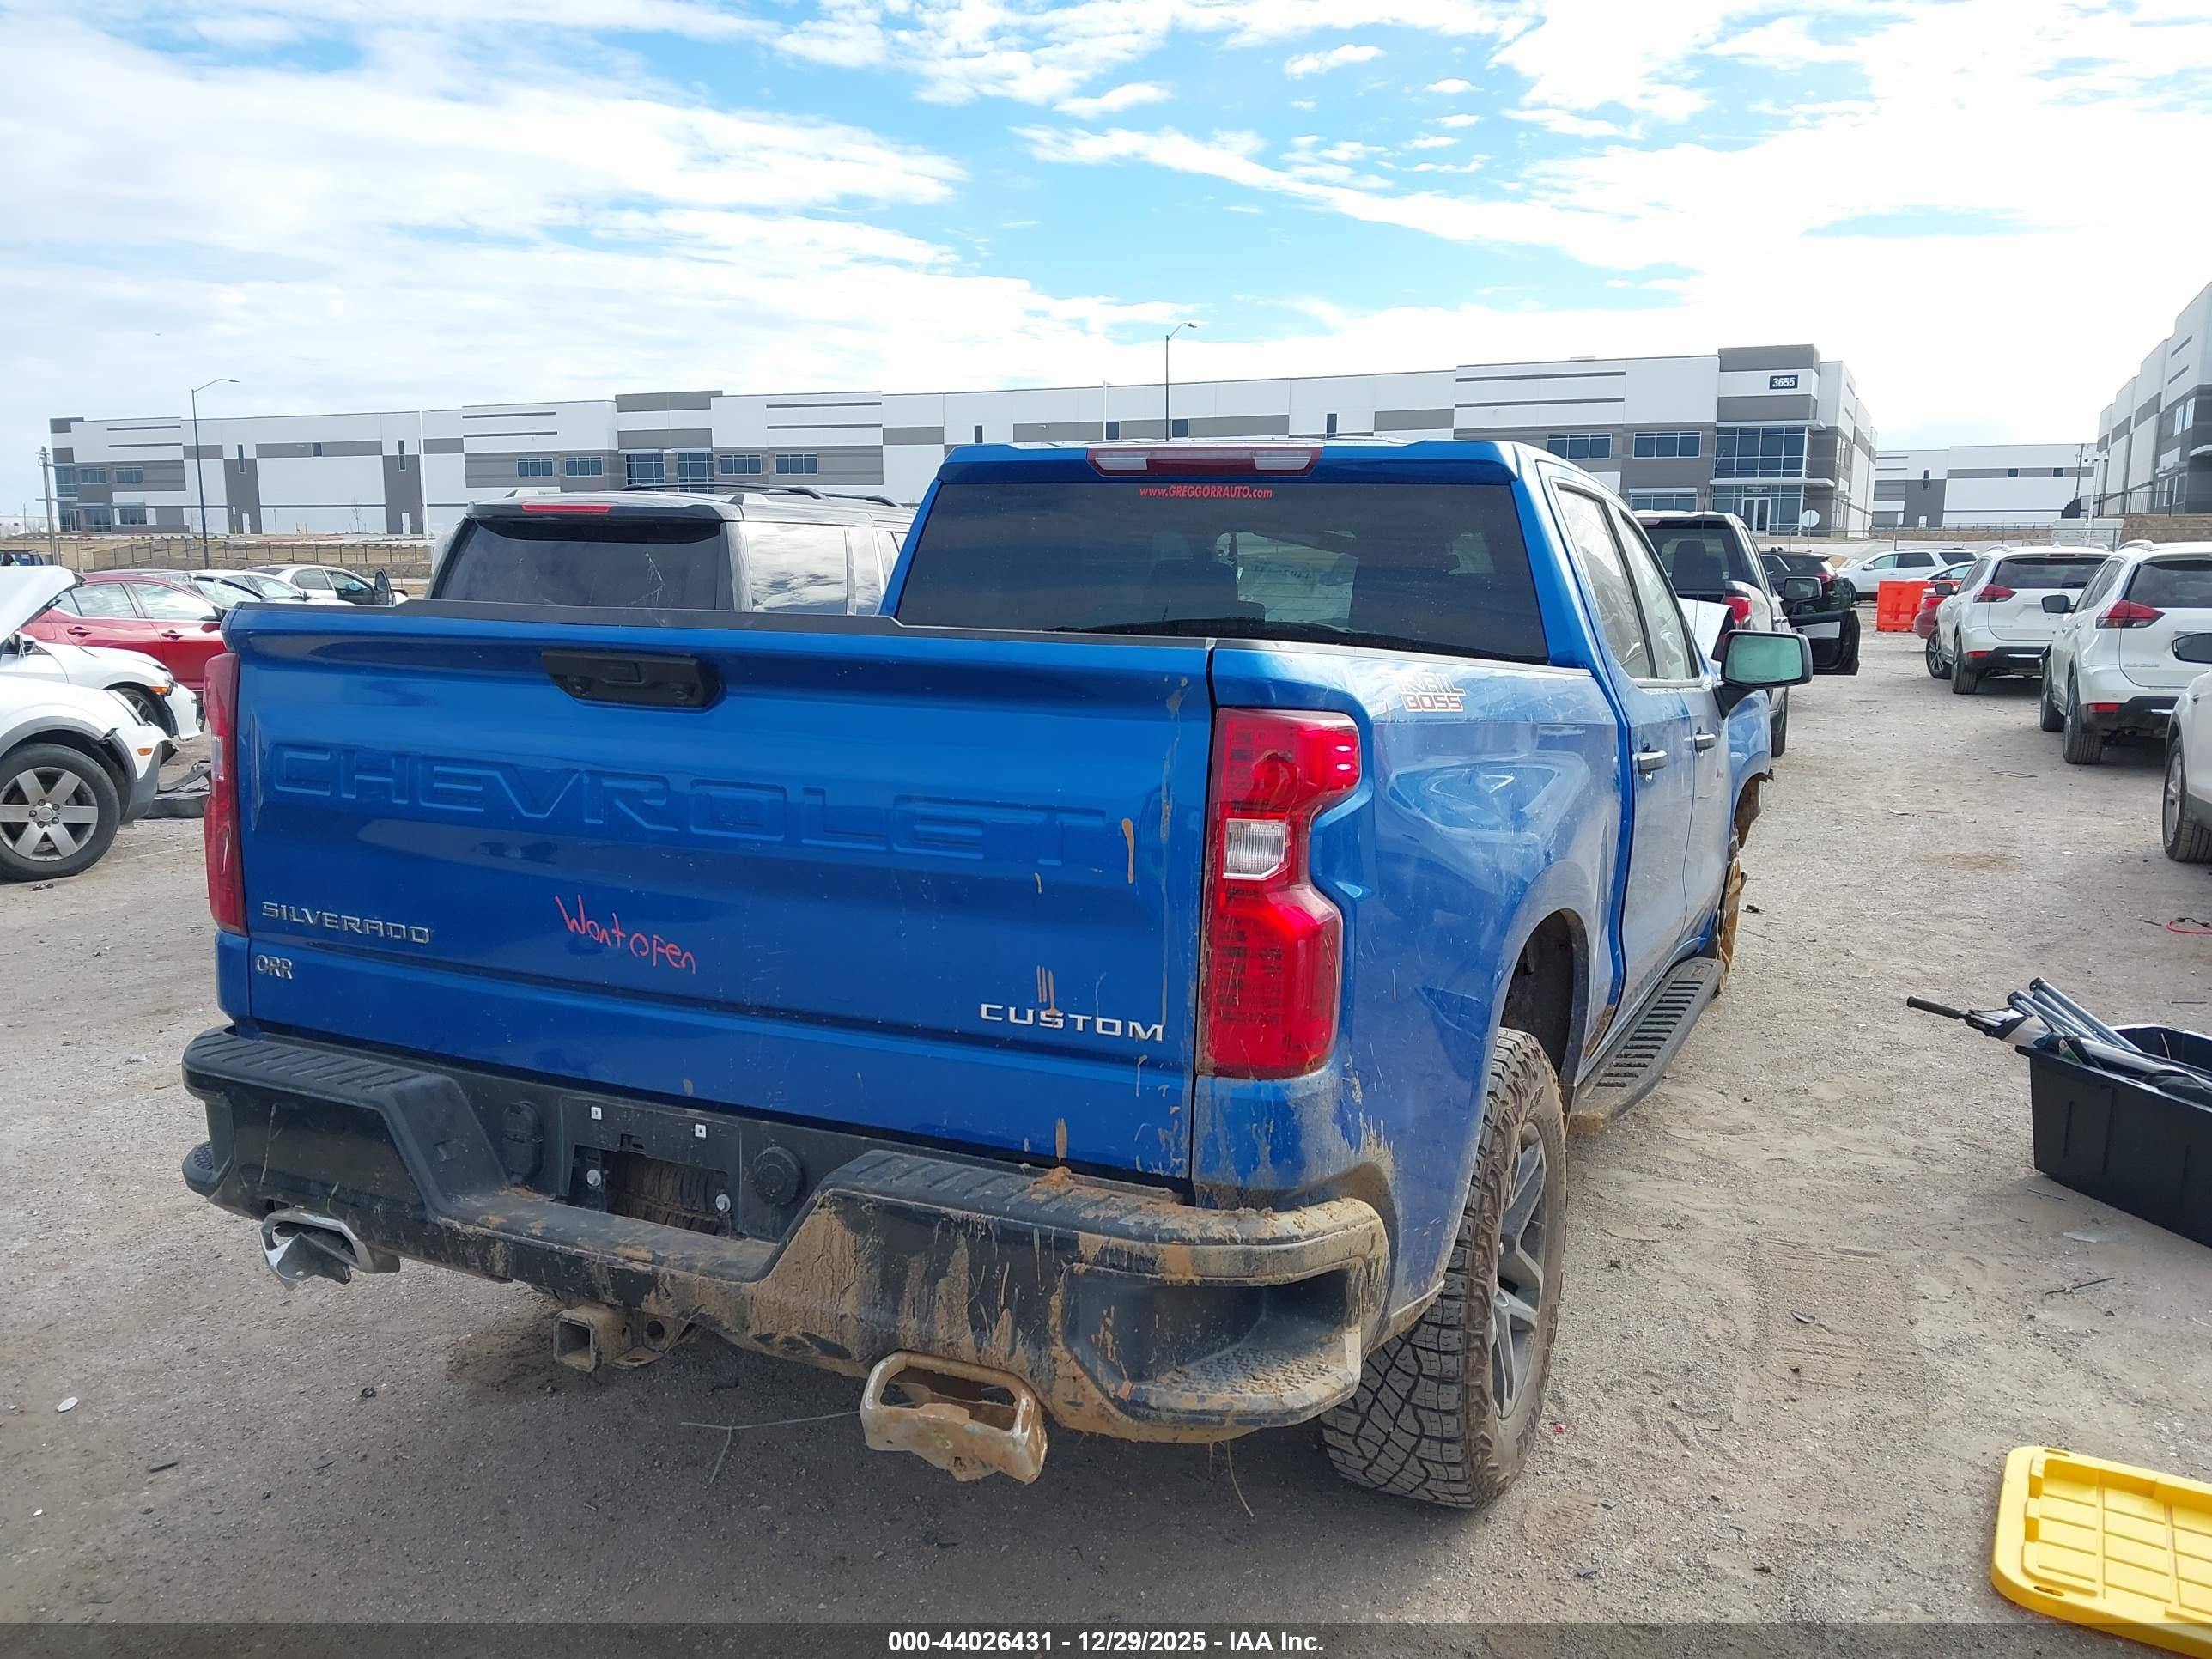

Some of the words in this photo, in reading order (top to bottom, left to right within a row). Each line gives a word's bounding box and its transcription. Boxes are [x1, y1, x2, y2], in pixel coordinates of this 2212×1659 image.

[1772, 377, 1796, 387] 3655
[1139, 485, 1273, 499] www.GREGGORRAUTO.com
[1401, 693, 1464, 713] BOSS
[274, 745, 1107, 866] CHEVROLET
[261, 901, 430, 944] SILVERADO
[256, 954, 294, 980] ORR
[980, 1003, 1165, 1042] CUSTOM
